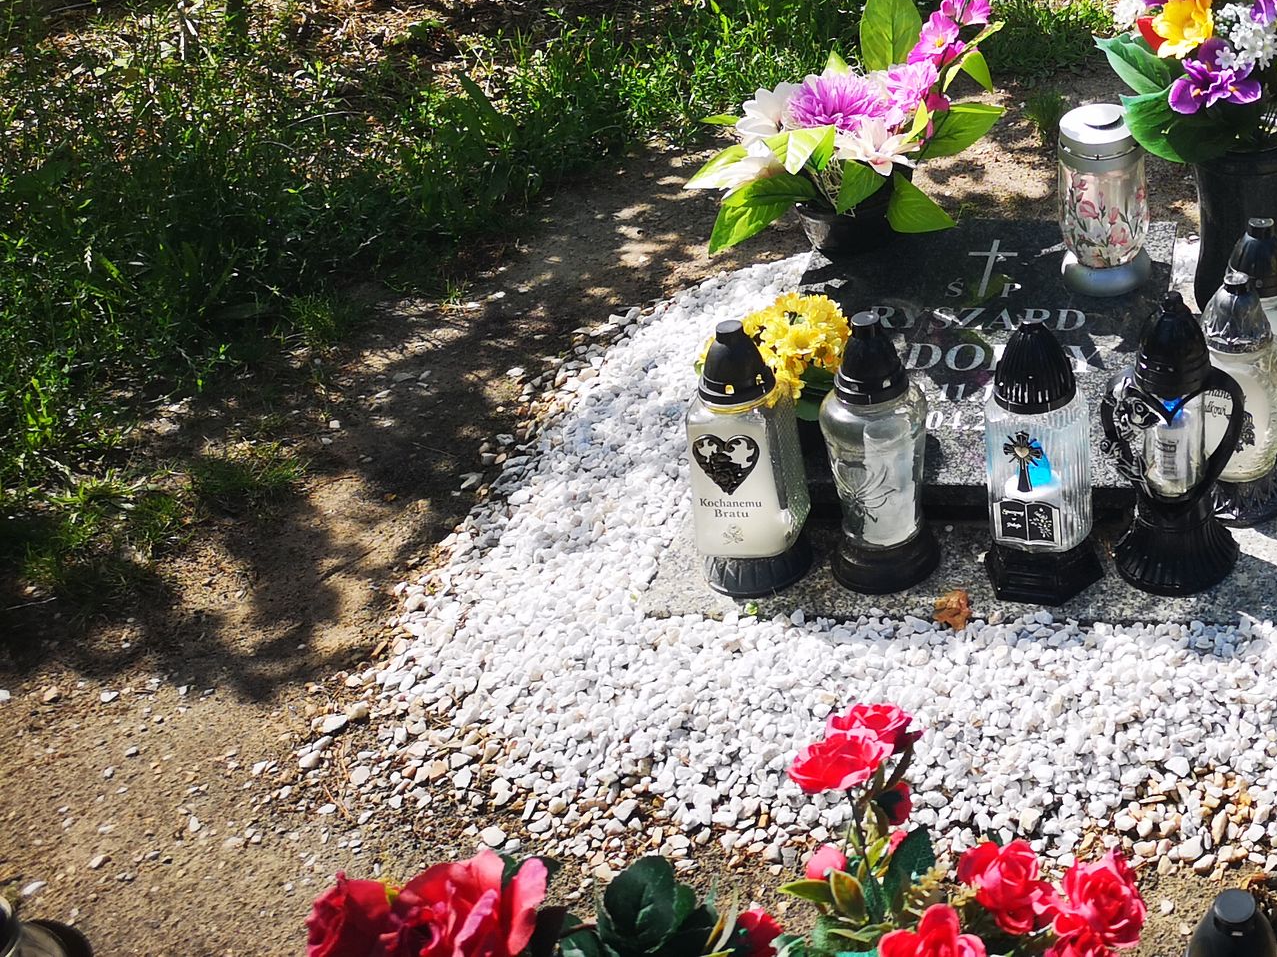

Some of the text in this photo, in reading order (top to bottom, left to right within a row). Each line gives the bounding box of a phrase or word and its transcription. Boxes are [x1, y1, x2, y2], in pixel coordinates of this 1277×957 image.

[945, 277, 1022, 298] Ś P
[870, 305, 1086, 331] RYSZARD
[699, 497, 762, 508] Kochanemu
[714, 508, 750, 518] Bratu
